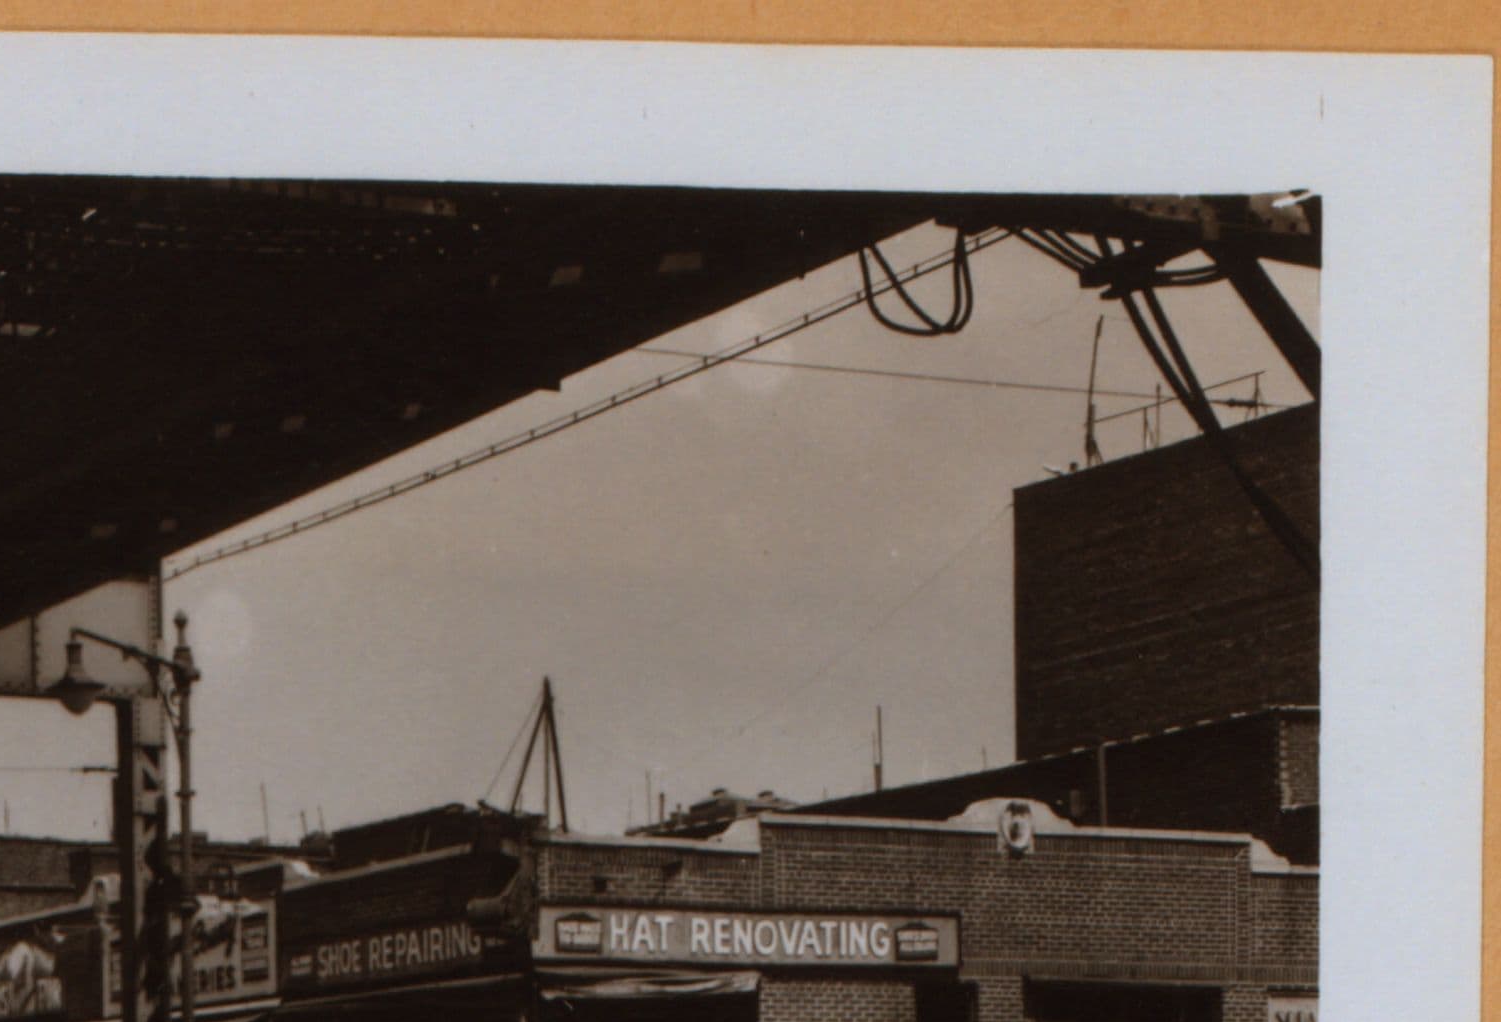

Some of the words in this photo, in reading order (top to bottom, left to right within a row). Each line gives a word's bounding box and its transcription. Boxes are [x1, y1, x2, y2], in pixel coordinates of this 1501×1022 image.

[316, 939, 363, 979] SHOE
[368, 921, 483, 973] REPAIRING
[609, 912, 674, 954] HAT
[690, 916, 892, 959] RENOVATING
